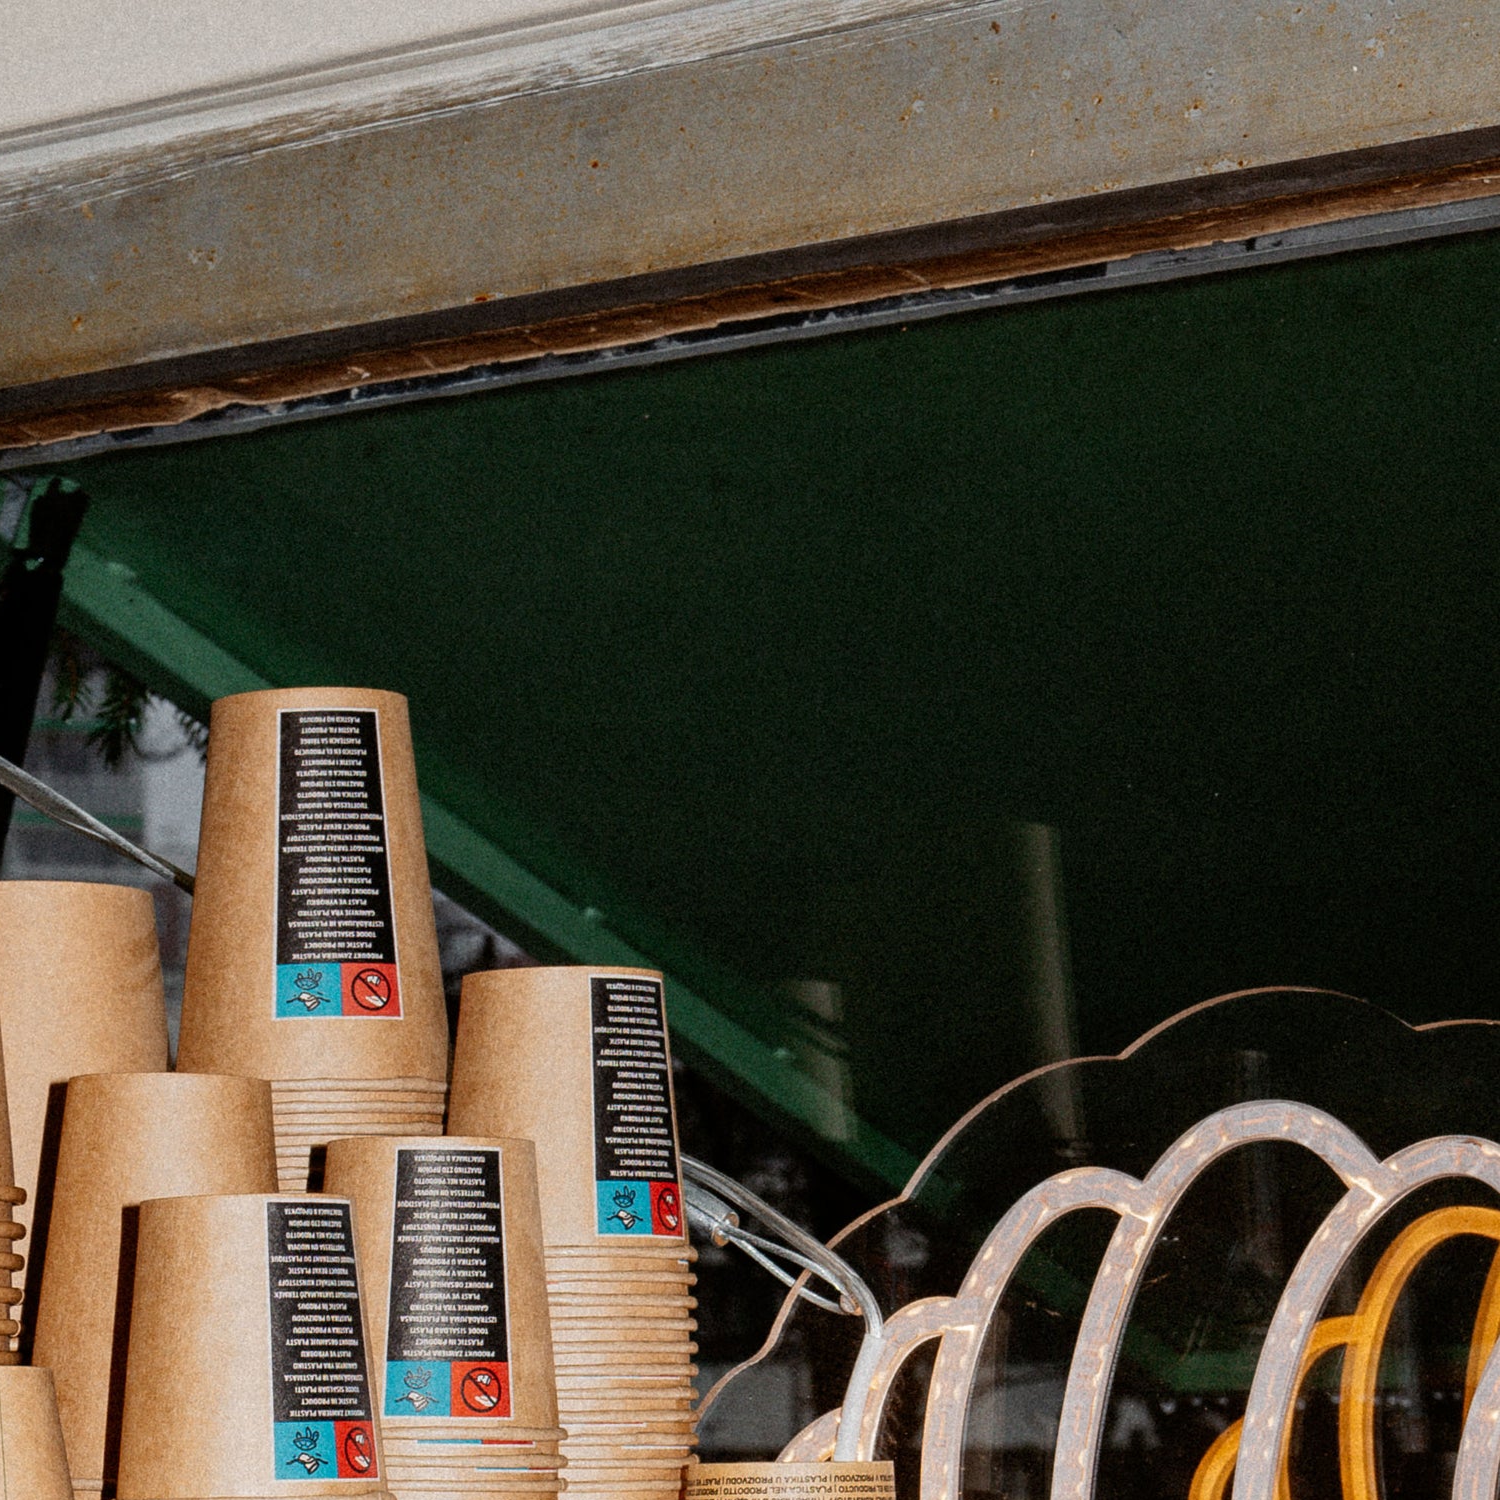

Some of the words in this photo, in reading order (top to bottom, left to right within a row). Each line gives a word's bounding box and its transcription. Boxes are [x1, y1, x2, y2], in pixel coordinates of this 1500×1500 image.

[726, 1476, 773, 1485] PROIZVODU
[776, 1476, 781, 1484] U
[784, 1475, 827, 1483] PLASTIKA
[723, 1487, 767, 1495] PRODOTTO
[769, 1486, 788, 1494] NEL
[839, 1485, 876, 1493] PRODUCTO
